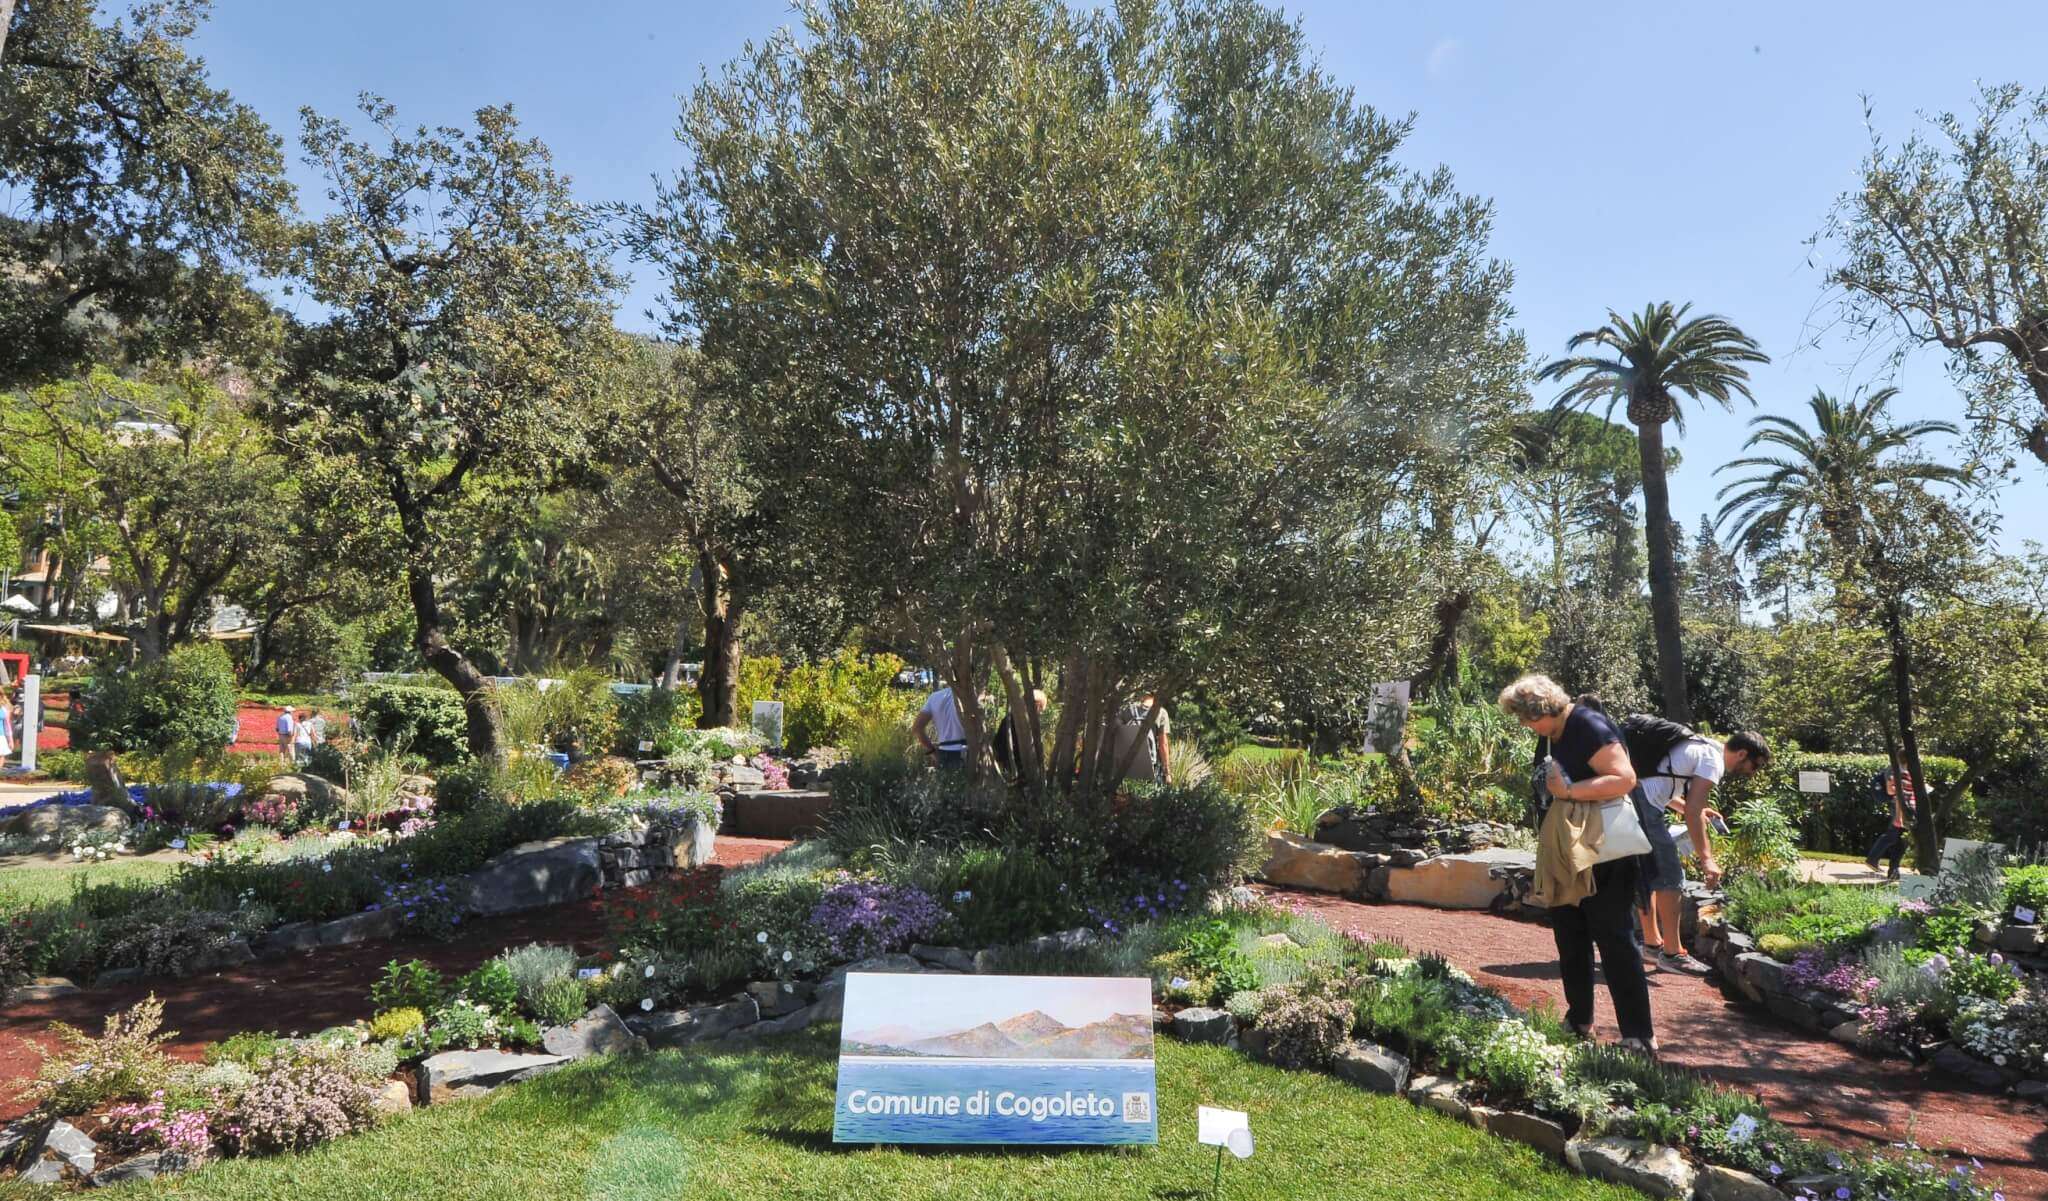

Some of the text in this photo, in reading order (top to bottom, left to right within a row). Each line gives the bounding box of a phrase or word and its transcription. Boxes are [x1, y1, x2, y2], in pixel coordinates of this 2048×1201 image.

[847, 1089, 1115, 1122] Comune di Cogoleto
